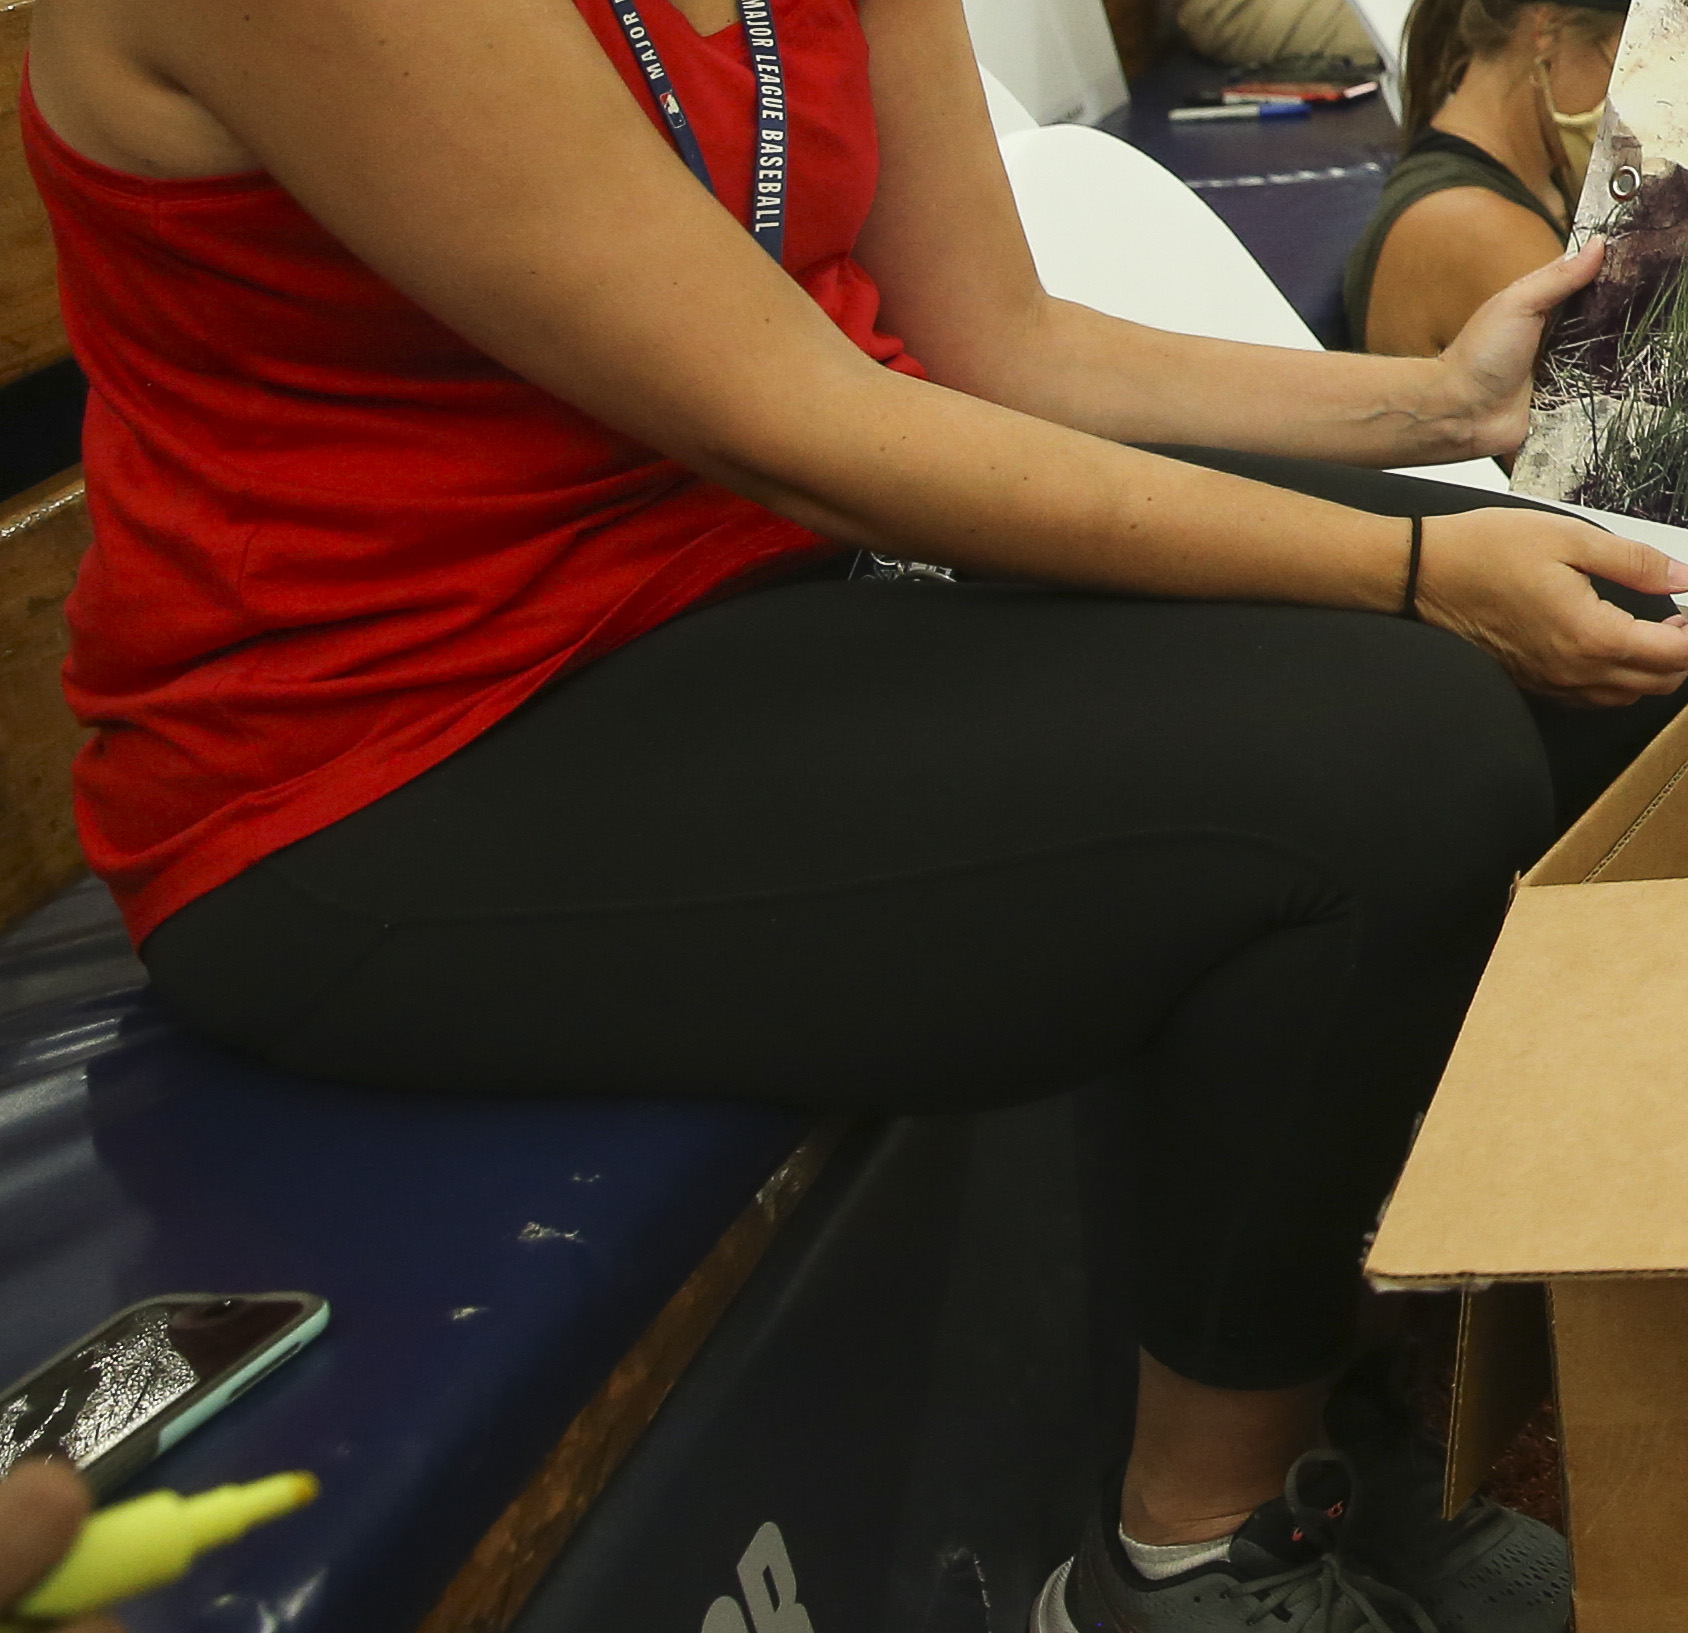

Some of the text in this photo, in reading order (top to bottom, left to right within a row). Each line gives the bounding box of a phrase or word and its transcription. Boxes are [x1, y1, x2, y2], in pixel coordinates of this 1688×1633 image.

[622, 11, 664, 80] MAJOR
[755, 54, 784, 121] LEAGUE
[755, 129, 785, 233] BASEBALL
